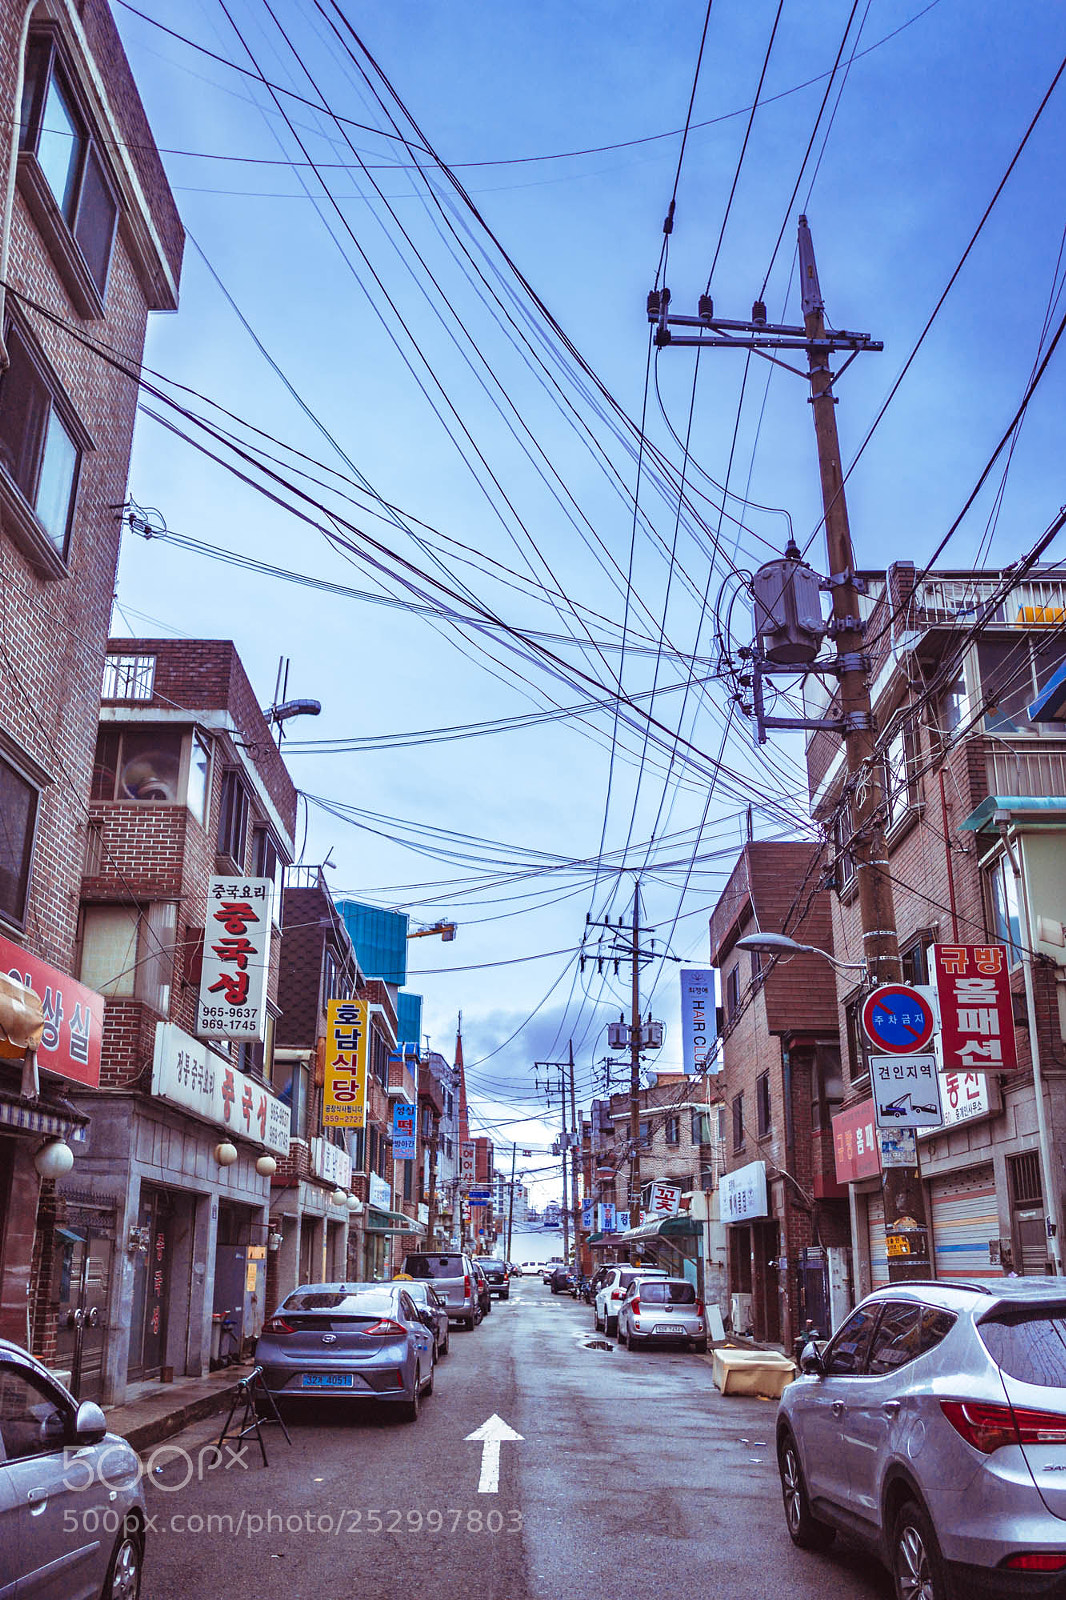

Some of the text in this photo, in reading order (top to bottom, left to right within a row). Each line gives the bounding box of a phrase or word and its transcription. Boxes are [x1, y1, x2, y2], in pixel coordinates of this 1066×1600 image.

[211, 883, 267, 901] 중국요리
[207, 902, 260, 1006] 중국성
[940, 946, 1004, 975] 규방
[201, 1018, 257, 1031] 969-1745
[202, 1006, 258, 1019] 965-9637
[874, 1012, 924, 1026] 주차금지
[953, 977, 1004, 1067] 홈패션
[692, 1000, 707, 1073] HAIR CLUB
[331, 1004, 362, 1102] 호남식당
[878, 1064, 932, 1080] 견인지역
[221, 1067, 267, 1141] 중국성
[397, 1119, 413, 1137] 떡
[655, 1187, 677, 1212] 꽃
